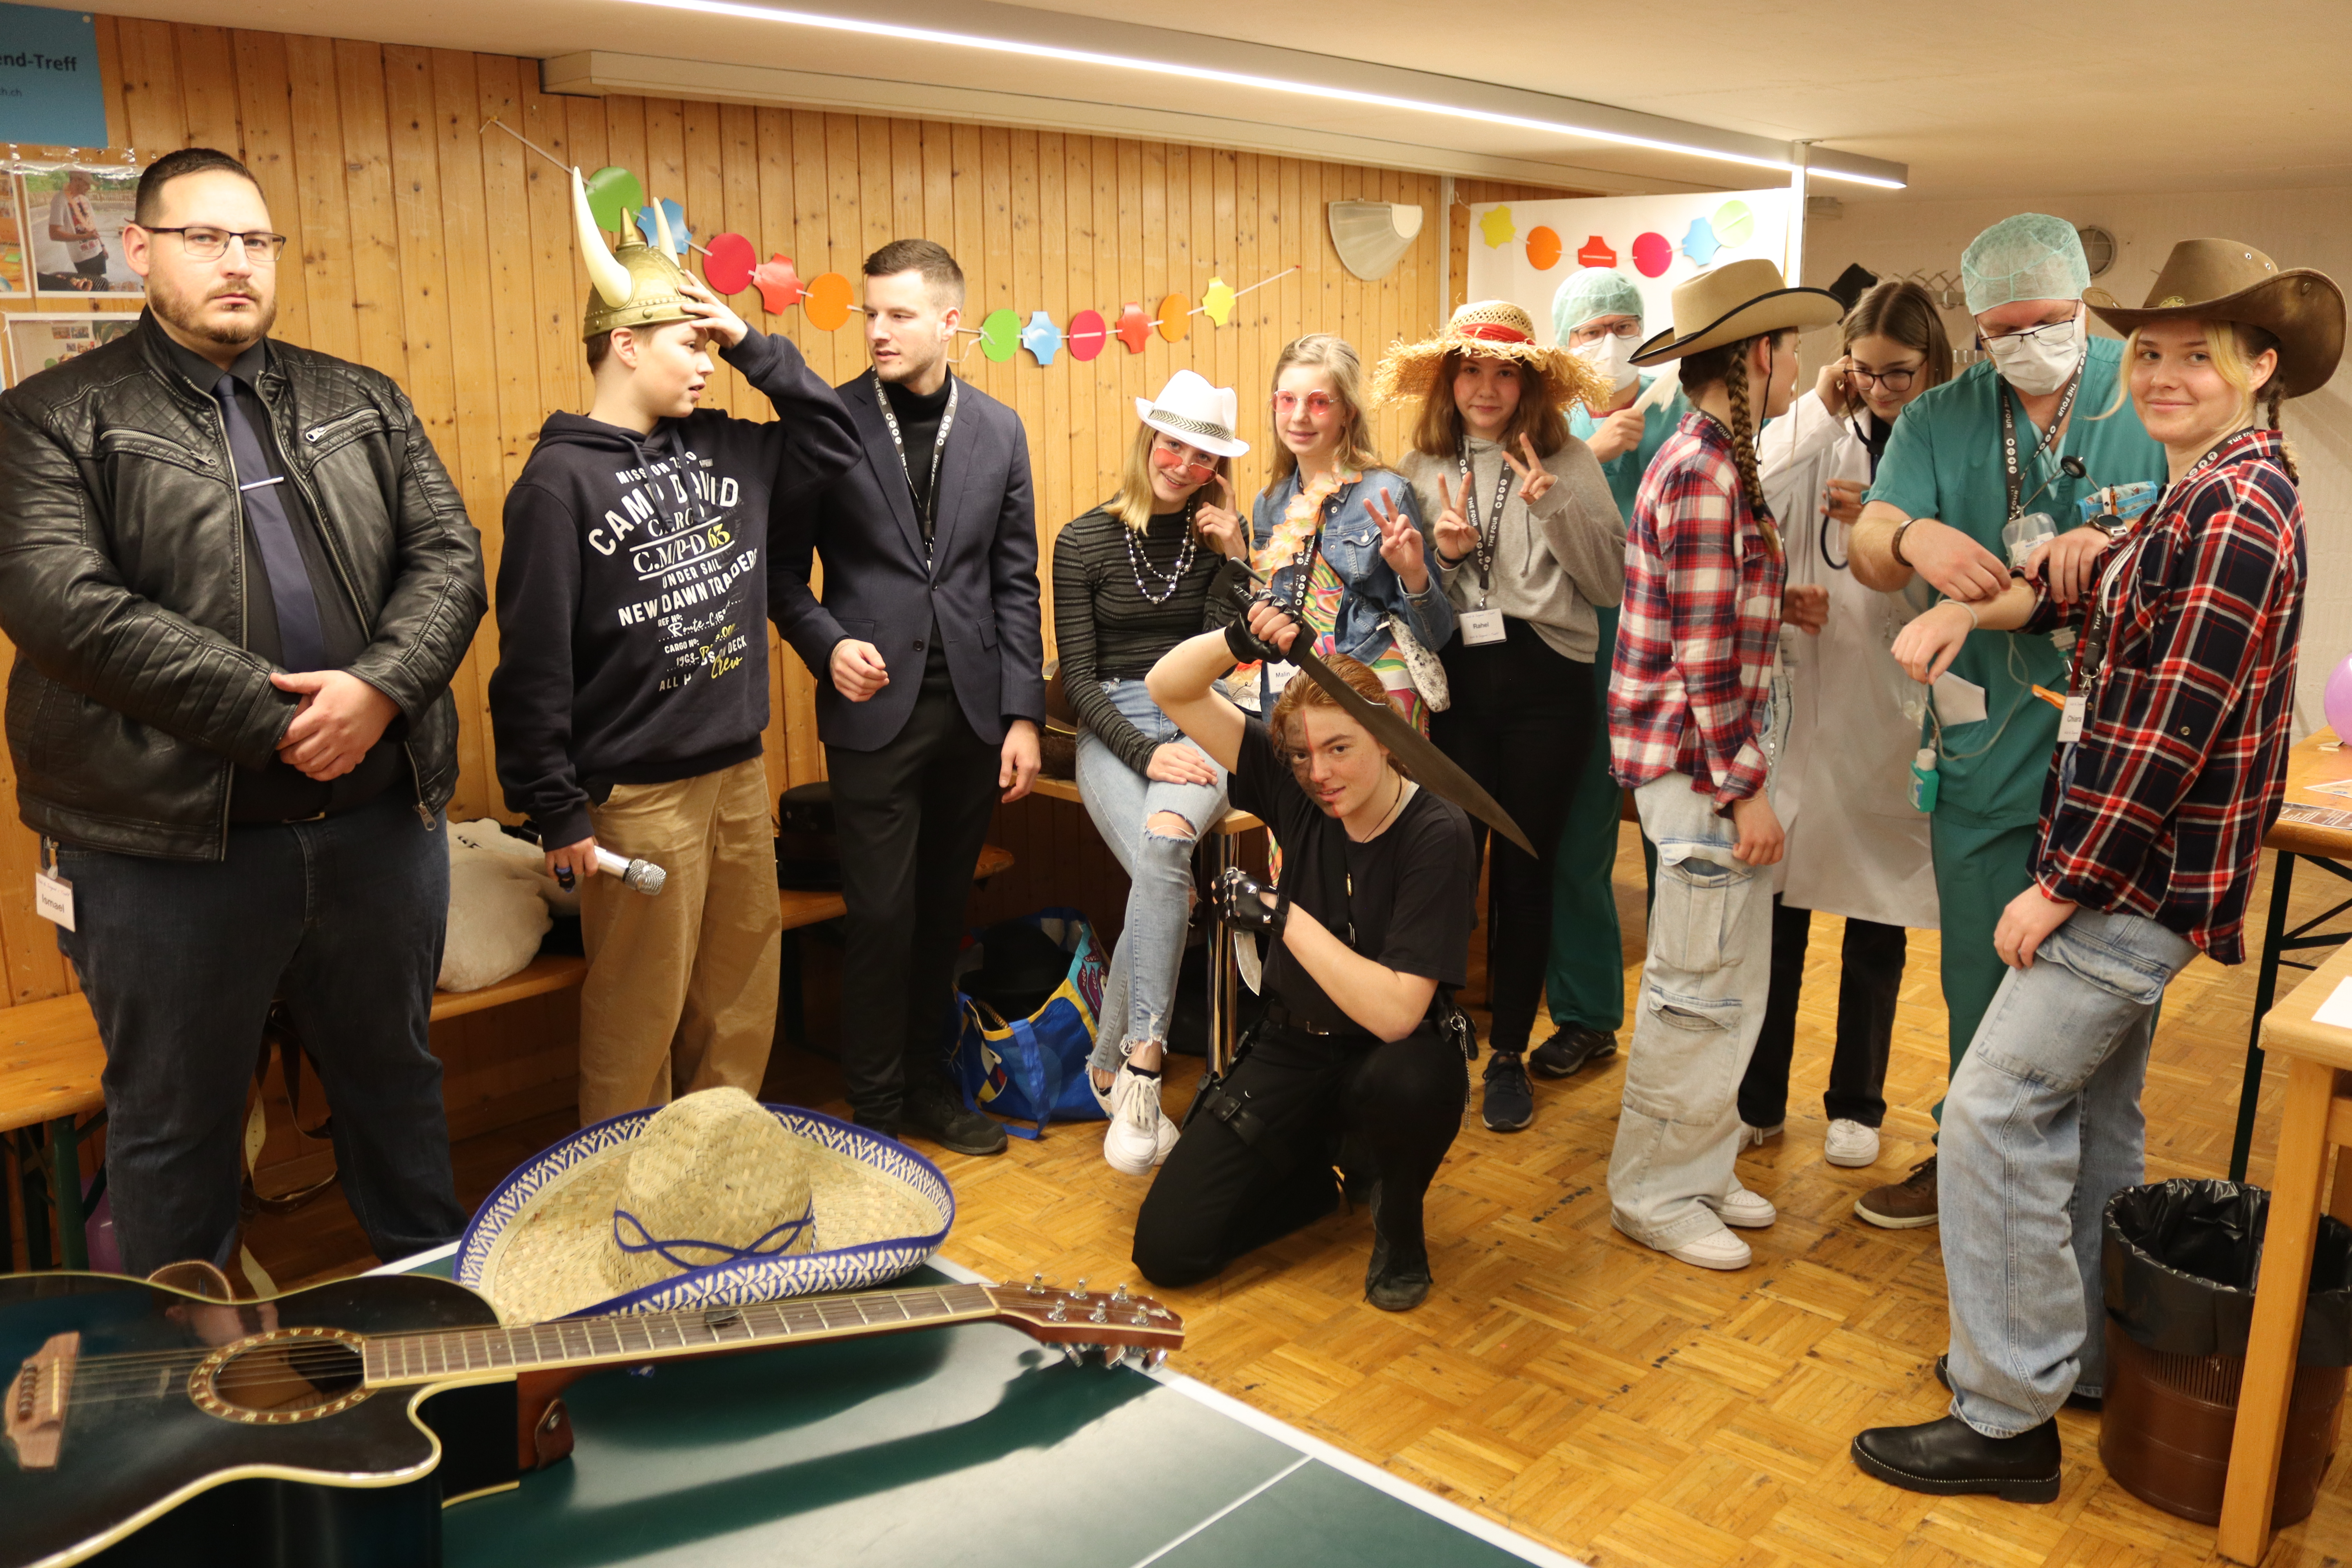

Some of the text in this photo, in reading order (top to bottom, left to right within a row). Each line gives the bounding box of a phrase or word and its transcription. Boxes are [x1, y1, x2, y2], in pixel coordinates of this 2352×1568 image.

[0, 52, 77, 71] nd-Treff
[877, 388, 887, 405] FOUR
[2058, 383, 2077, 417] THE FOUR
[1715, 424, 1731, 439] FOUR
[615, 463, 670, 484] MISSON
[1470, 510, 1478, 526] FOUR
[1490, 516, 1498, 534] FOUR
[707, 523, 730, 548] 63
[662, 558, 722, 589] UNDER SAIL
[618, 599, 658, 626] NEW
[661, 582, 709, 613] DAWN
[658, 617, 669, 627] REF
[664, 641, 688, 654] CARGO
[659, 677, 679, 691] ALL
[728, 635, 747, 654] DECK
[711, 654, 747, 679] Crew
[42, 893, 65, 913] Ismael
